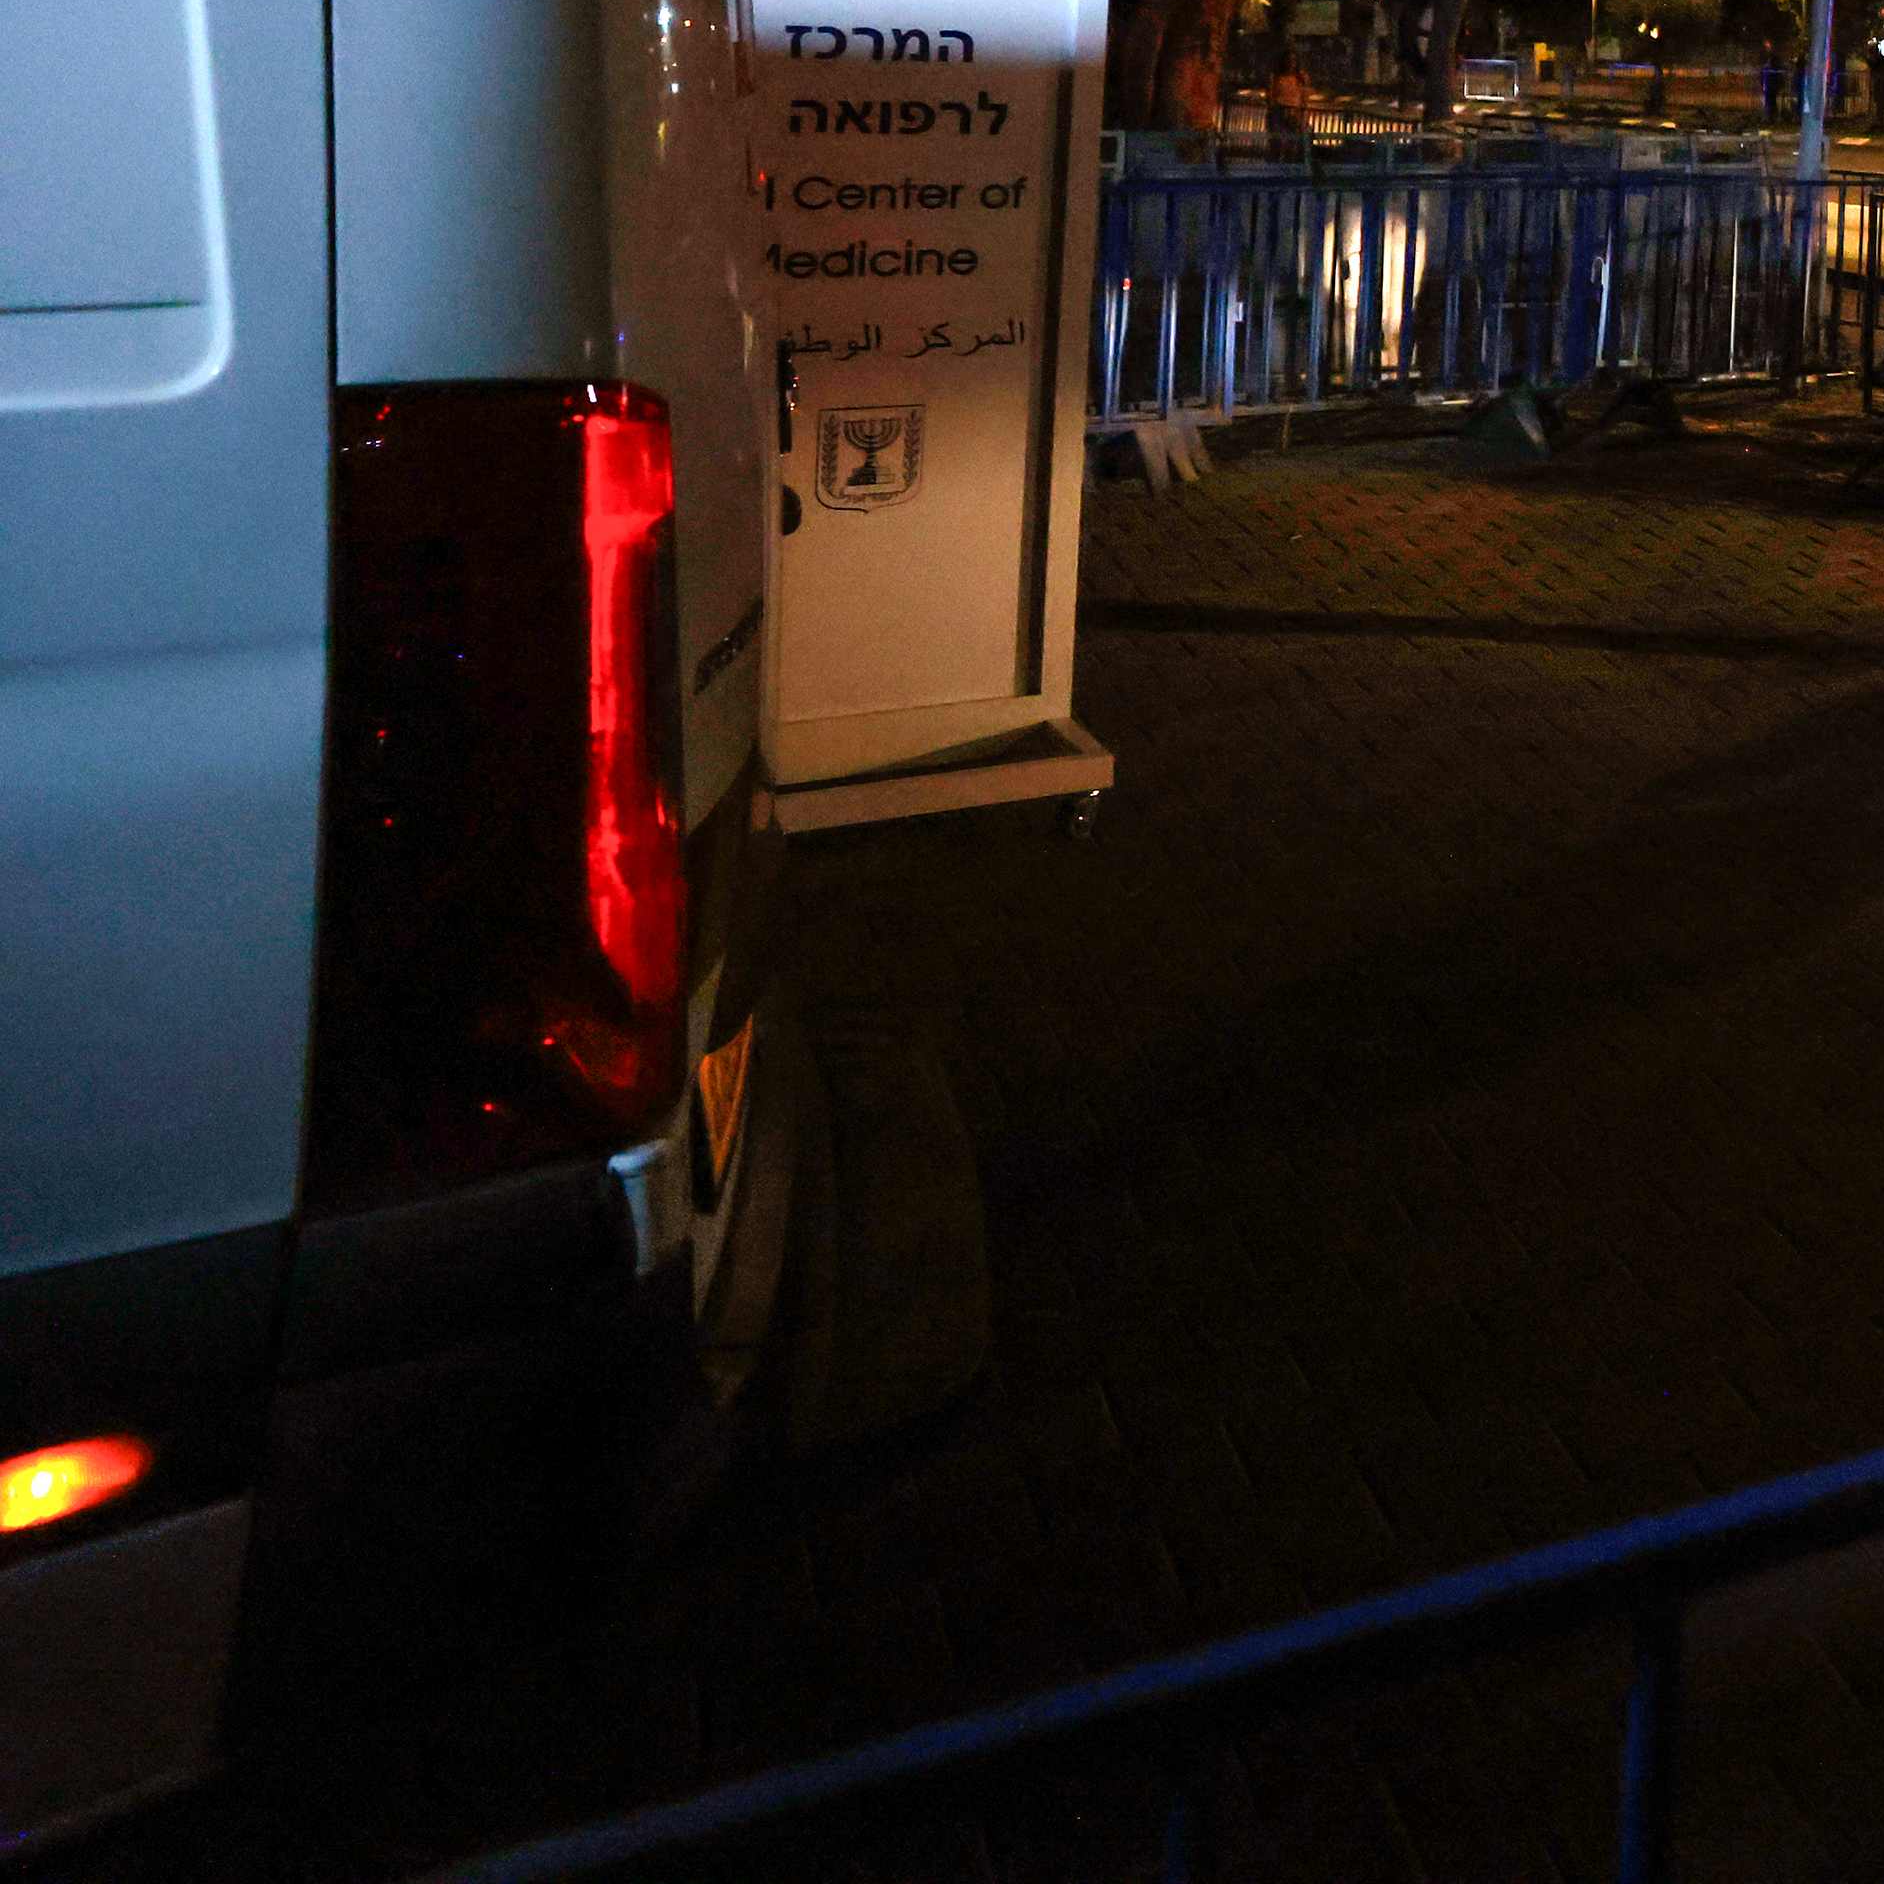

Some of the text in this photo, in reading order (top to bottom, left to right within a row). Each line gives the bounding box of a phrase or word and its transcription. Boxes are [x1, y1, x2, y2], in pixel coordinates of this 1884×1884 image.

[785, 25, 975, 63] המרכז
[789, 90, 1008, 135] לרפואה
[792, 176, 965, 210] Center
[979, 175, 1028, 209] of
[903, 318, 1026, 358] المركز
